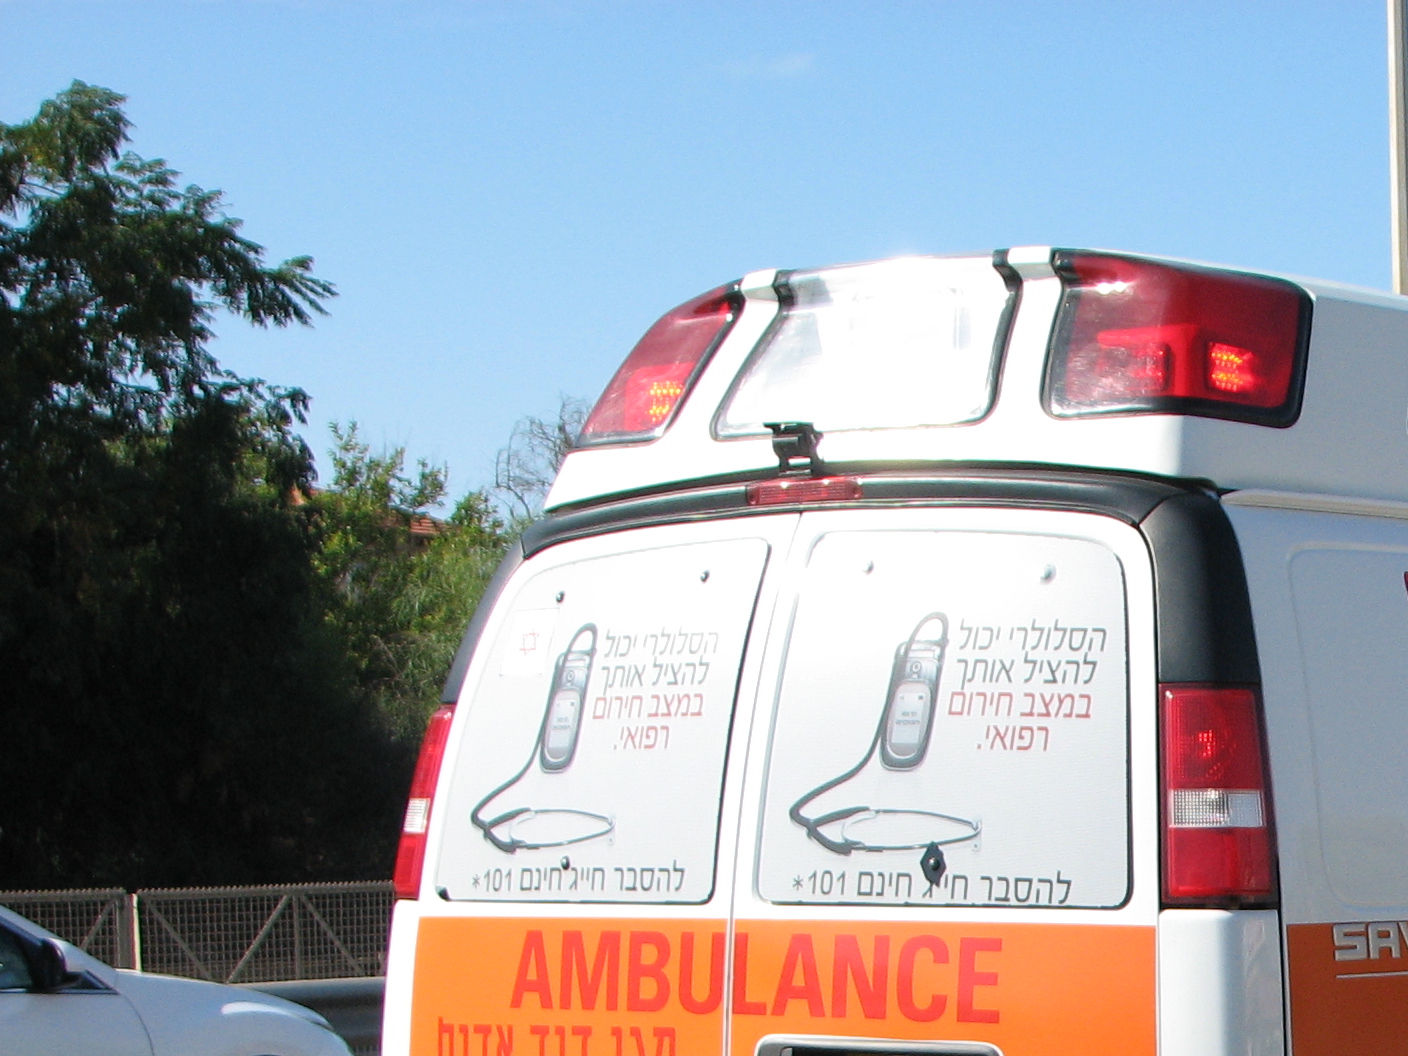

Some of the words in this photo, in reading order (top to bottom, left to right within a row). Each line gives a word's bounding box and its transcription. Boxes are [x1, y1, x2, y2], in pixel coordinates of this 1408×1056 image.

[604, 629, 638, 658] יכול
[643, 626, 719, 656] הסלולרי
[959, 618, 1001, 650] יכול
[1009, 618, 1107, 652] הסלולרי
[601, 664, 646, 696] אותך
[651, 654, 710, 686] להציל
[956, 658, 1015, 690] אותך
[1023, 651, 1098, 684] להציל
[592, 694, 643, 719] חירום
[647, 693, 703, 717] במצב
[948, 691, 1013, 716] חירום
[1020, 692, 1091, 719] במצב
[613, 725, 670, 750] רפואי.
[977, 725, 1049, 751] רפואי.
[520, 867, 561, 891] חינם
[569, 867, 606, 891] חייג
[613, 859, 686, 891] להסבר
[857, 871, 912, 898] חינם
[980, 870, 1072, 904] להסבר
[510, 929, 1003, 1024] AMBULANCE
